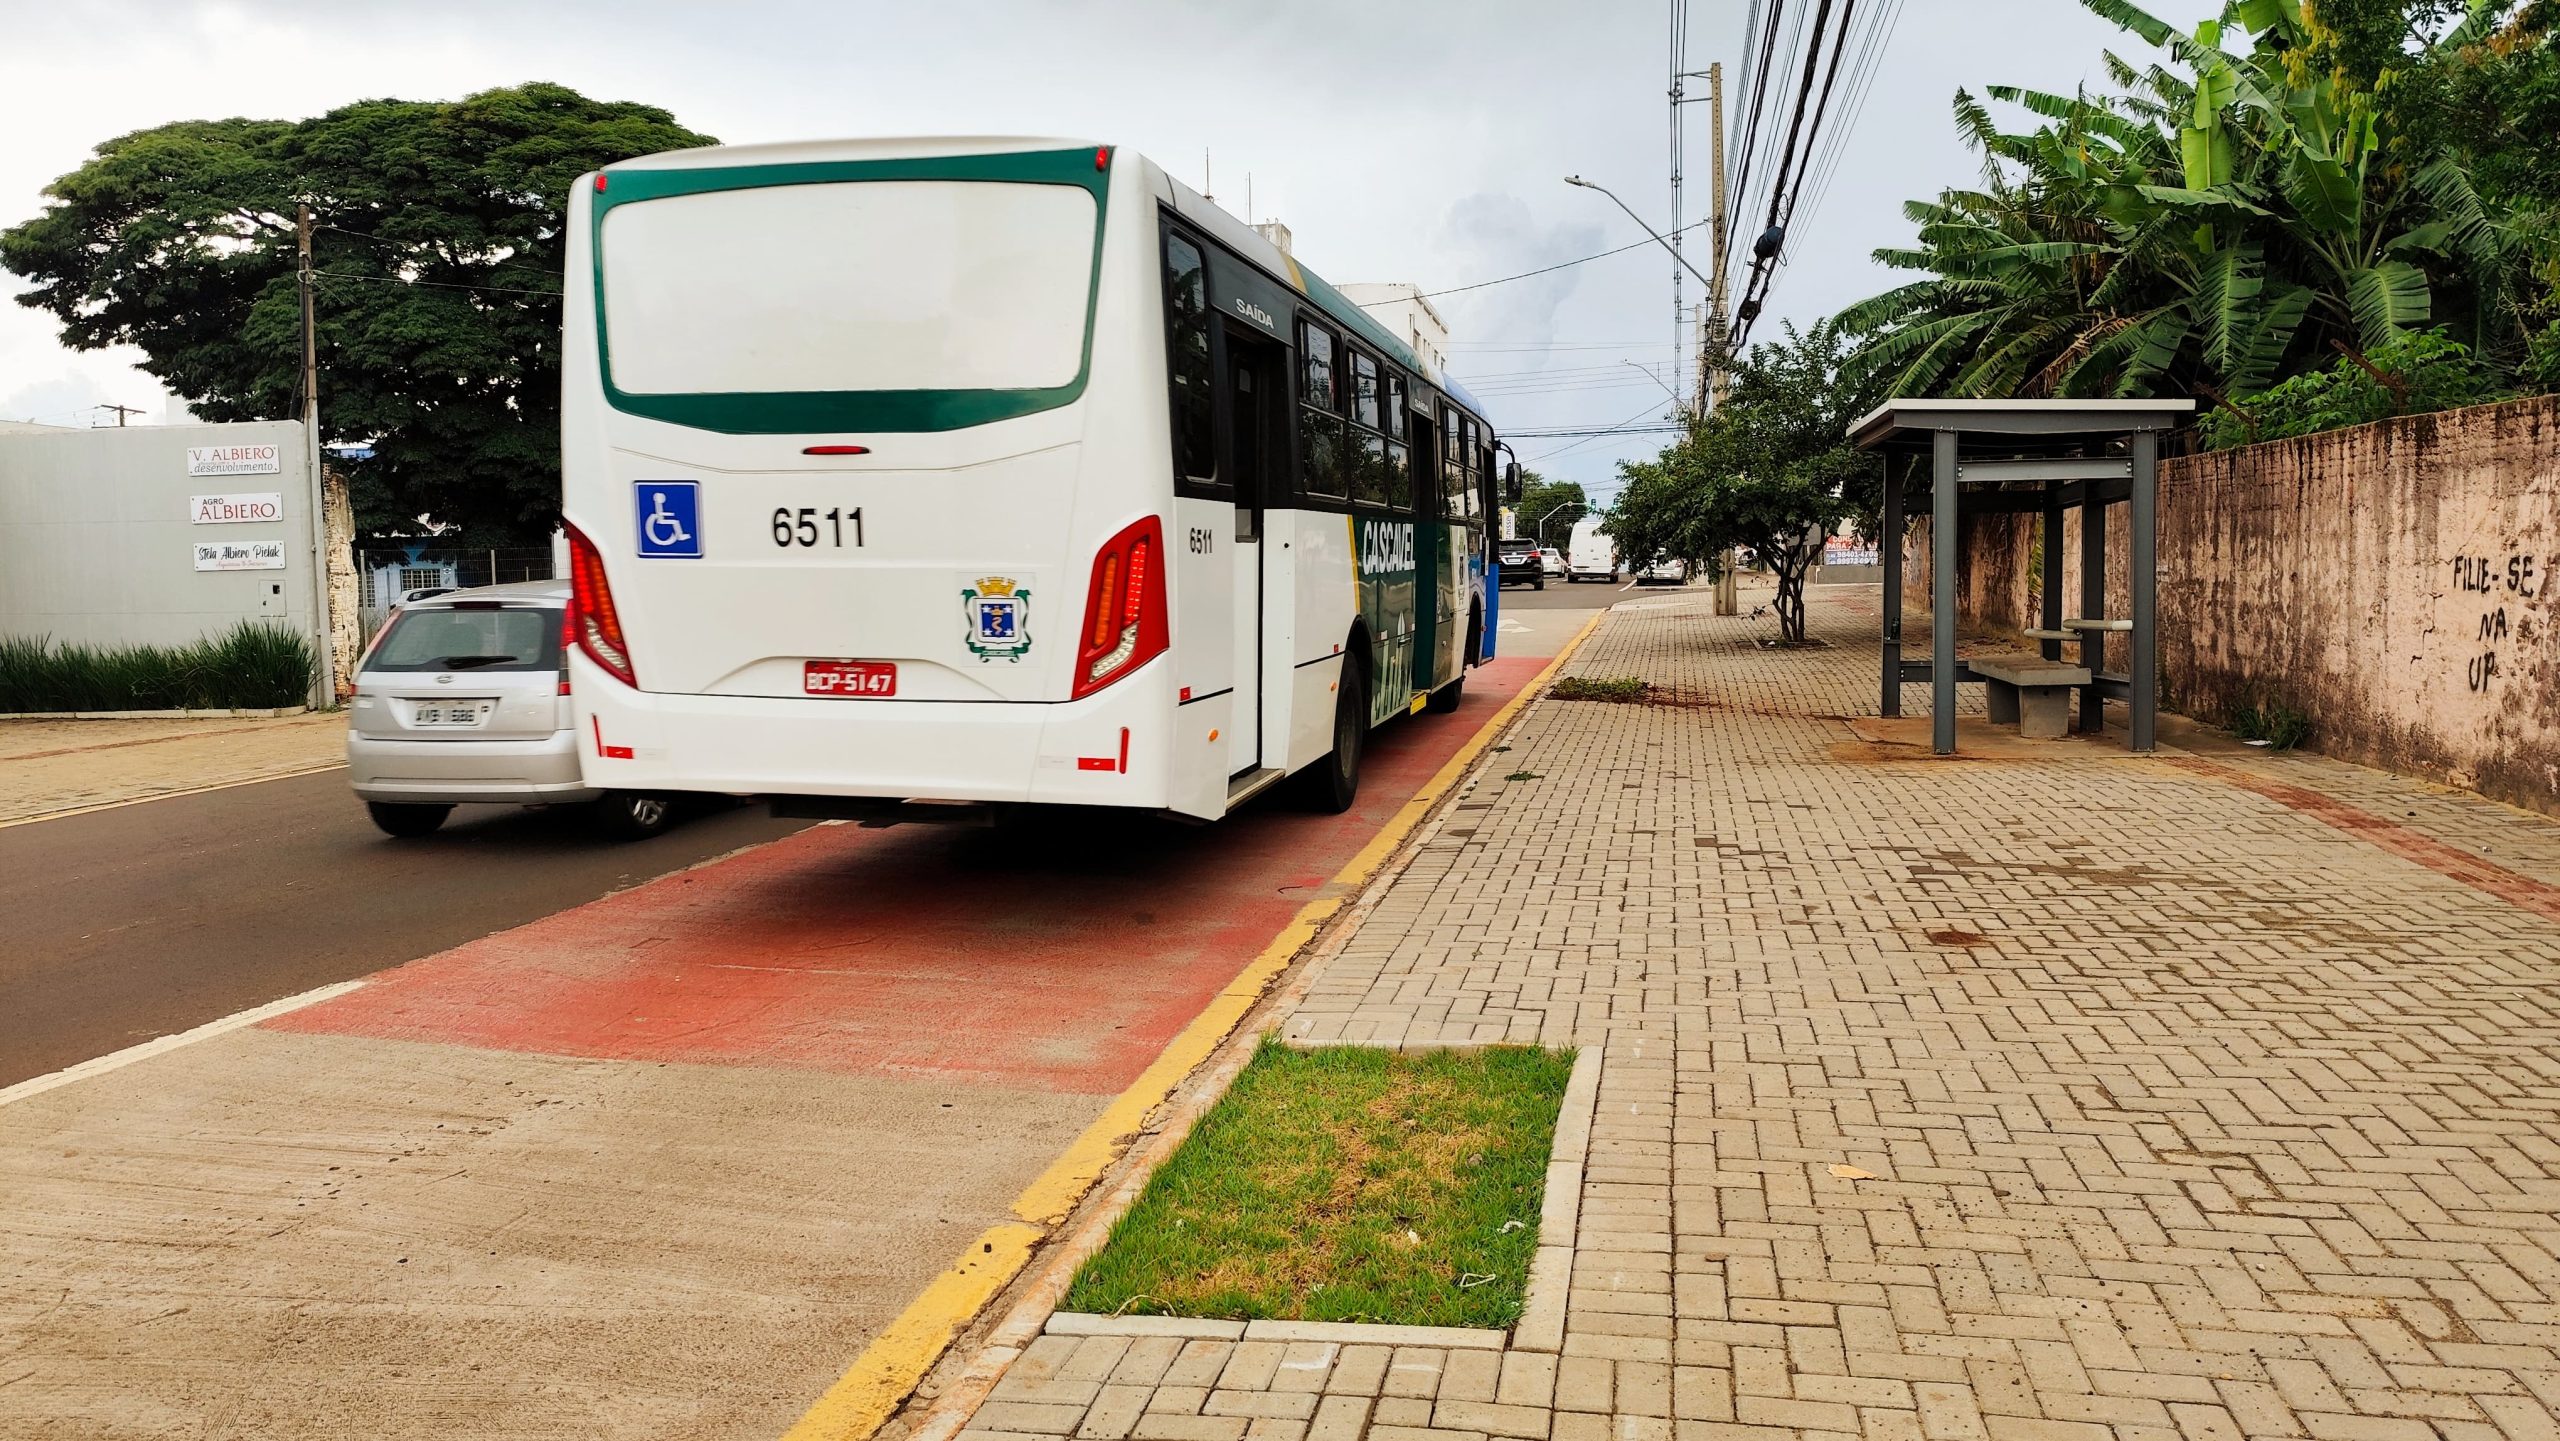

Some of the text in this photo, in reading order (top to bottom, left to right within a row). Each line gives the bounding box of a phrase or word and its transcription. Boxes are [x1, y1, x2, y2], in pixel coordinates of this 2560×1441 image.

[1235, 299, 1274, 329] SAÍDA
[1414, 399, 1429, 413] SAÍDA
[192, 447, 274, 461] V. ALBIERO
[194, 461, 273, 473] desenvolvimento
[199, 503, 275, 520] ALBIERO
[772, 507, 864, 547] 6511
[1190, 528, 1212, 554] 6511
[1363, 520, 1415, 575] CASCAVEL
[221, 546, 249, 560] Albiero
[2477, 607, 2507, 643] NA
[806, 673, 892, 692] BCP-5147
[2469, 651, 2496, 692] UP
